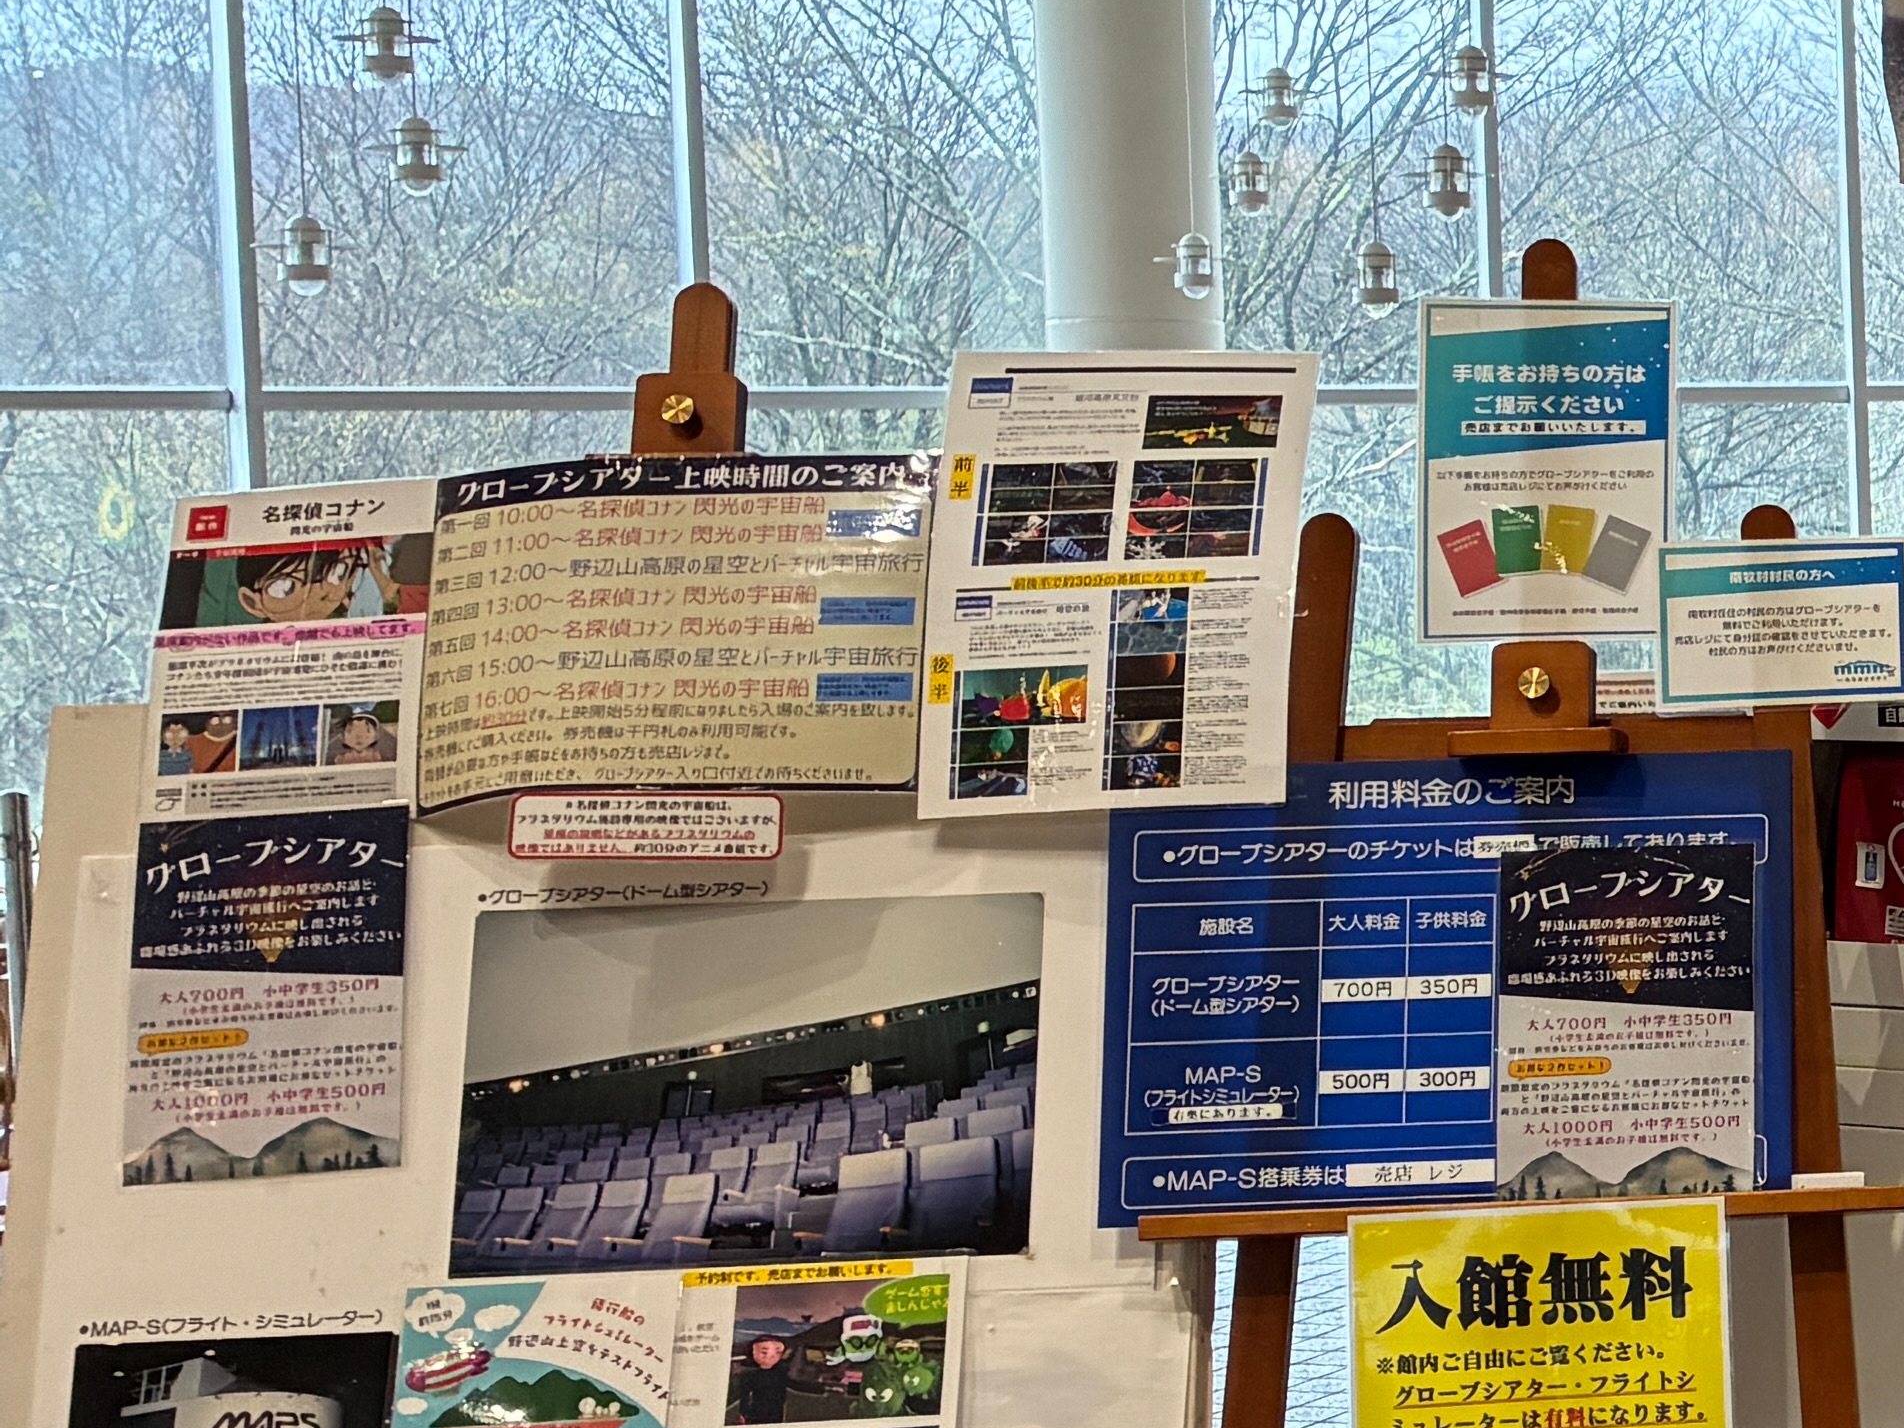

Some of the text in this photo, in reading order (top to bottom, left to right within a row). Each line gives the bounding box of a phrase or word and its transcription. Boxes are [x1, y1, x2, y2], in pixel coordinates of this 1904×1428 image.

[1452, 364, 1646, 383] 手帳をお持ちの方は
[1474, 395, 1624, 414] ご提示ください
[457, 462, 905, 504] グローブシアター上映時間のご案内
[262, 499, 385, 524] 名探偵コナン
[1729, 570, 1835, 584] 南牧村村民の方へ
[1328, 775, 1575, 811] 利用料金のご案内
[146, 836, 405, 894] グローブシアター
[1510, 870, 1750, 922] グローブシアター
[1199, 910, 1488, 936] 施設名 大人料金 子供料金
[1544, 950, 1715, 966] プラネタリウムに映し出される
[160, 978, 379, 1004] 大人700円 小中学生350円
[1151, 975, 1479, 998] グローブシアター 700円 350円
[1151, 996, 1300, 1018] (ドーム型シアター)
[1528, 1013, 1732, 1031] 大人700円 小中学生350円
[1185, 1065, 1476, 1089] MAP-S 500円 300円
[267, 1083, 386, 1103] 小中学生500円
[1144, 1085, 1300, 1109] (フライトシミュレーター)
[1523, 1115, 1740, 1135] 大人1000円 小中学生500円
[1167, 1163, 1464, 1191] MAP-S搭乗券は 売店 レジ
[1375, 1245, 1693, 1334] 入館無料
